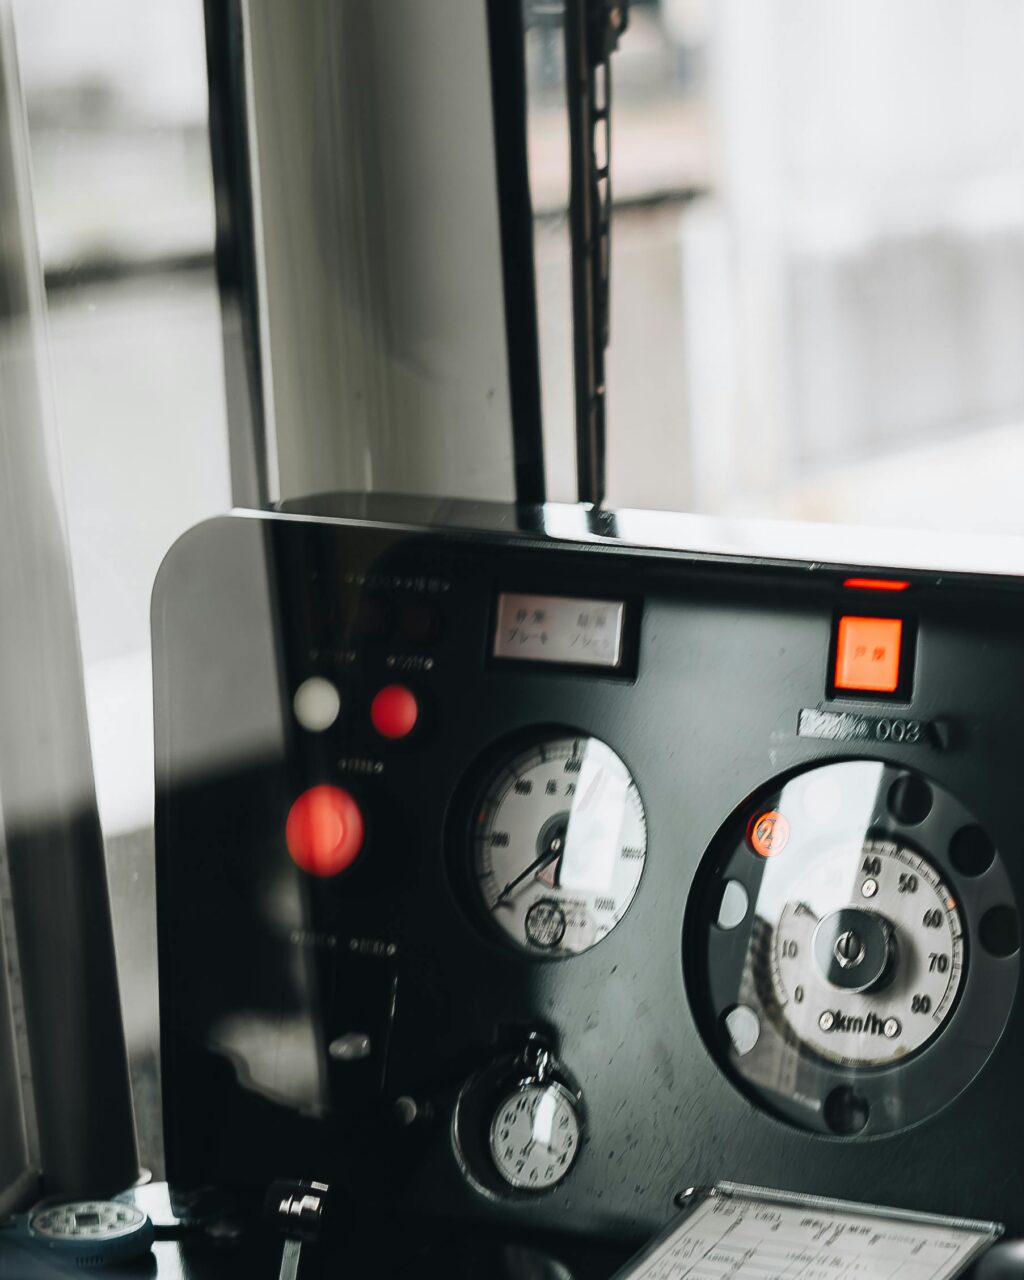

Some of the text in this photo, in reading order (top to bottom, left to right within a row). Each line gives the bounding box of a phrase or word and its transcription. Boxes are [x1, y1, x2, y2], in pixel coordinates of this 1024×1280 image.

[876, 718, 920, 743] 003
[862, 856, 881, 877] 40
[898, 873, 919, 894] 50
[923, 908, 943, 929] 60
[782, 939, 798, 959] 10
[928, 952, 950, 974] 70
[795, 984, 804, 1004] 0
[911, 994, 932, 1015] 80
[833, 1008, 887, 1036] km/h
